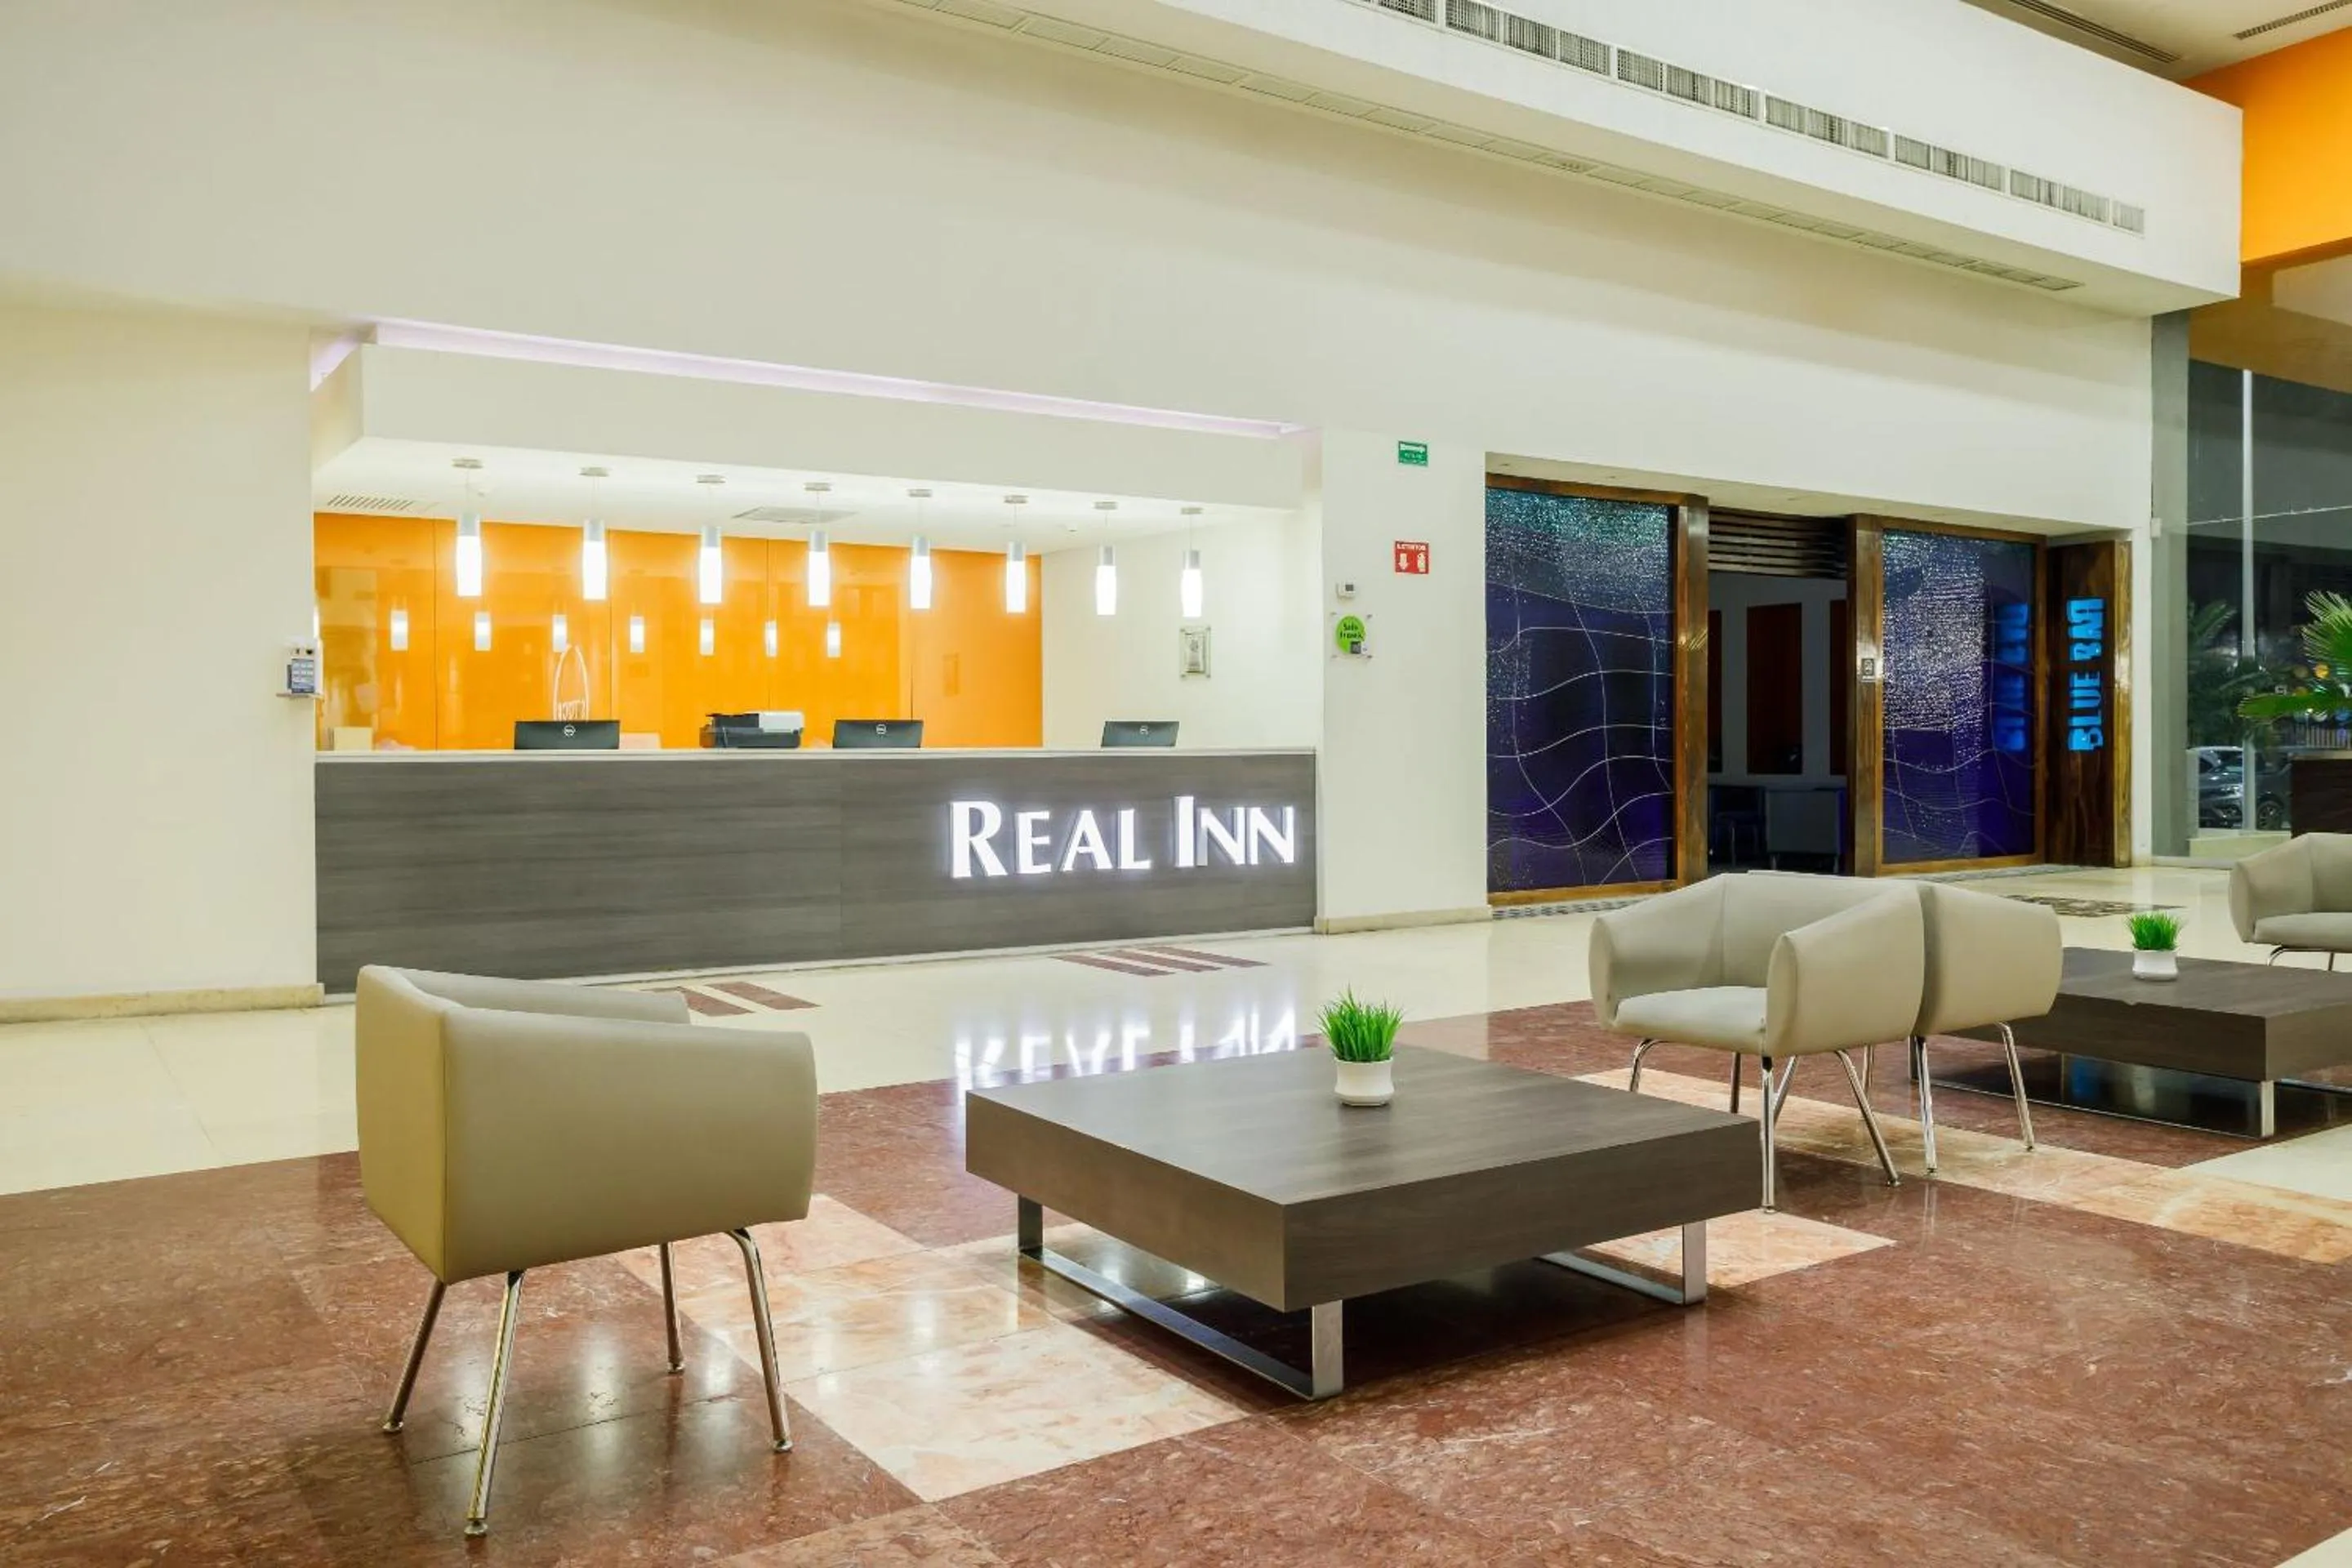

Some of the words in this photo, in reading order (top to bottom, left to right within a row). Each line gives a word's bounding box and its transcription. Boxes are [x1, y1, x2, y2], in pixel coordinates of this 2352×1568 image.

[2068, 599, 2104, 662] BAR
[2069, 671, 2104, 751] BLUE
[950, 800, 1152, 878] REAL
[1174, 795, 1295, 868] INN
